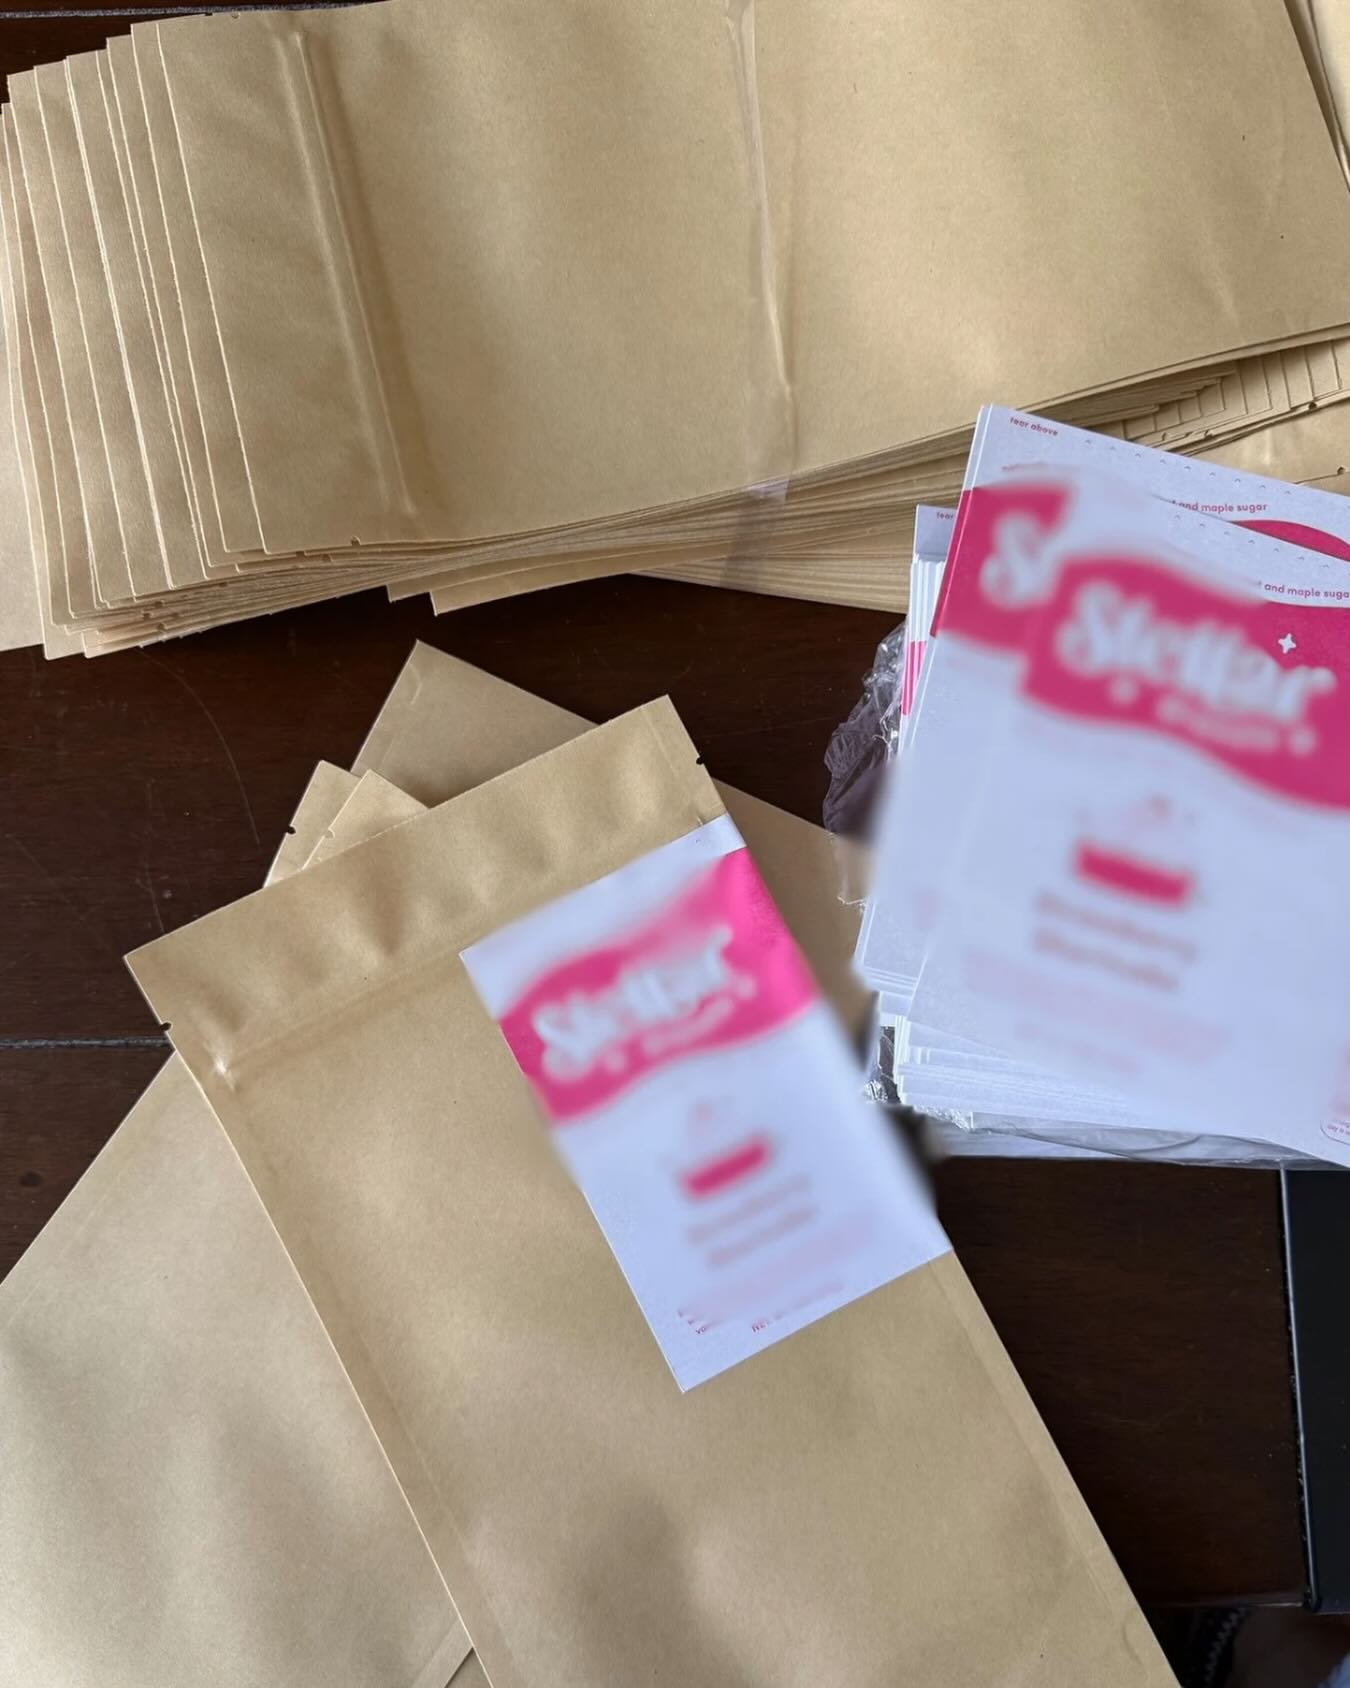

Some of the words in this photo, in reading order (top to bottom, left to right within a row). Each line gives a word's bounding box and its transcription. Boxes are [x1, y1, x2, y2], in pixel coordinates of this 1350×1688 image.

[1010, 416, 1029, 429] tear
[1030, 422, 1058, 436] above
[1201, 502, 1234, 515] maple
[1237, 503, 1268, 514] sugar
[1264, 583, 1285, 594] and
[1287, 587, 1321, 599] maple
